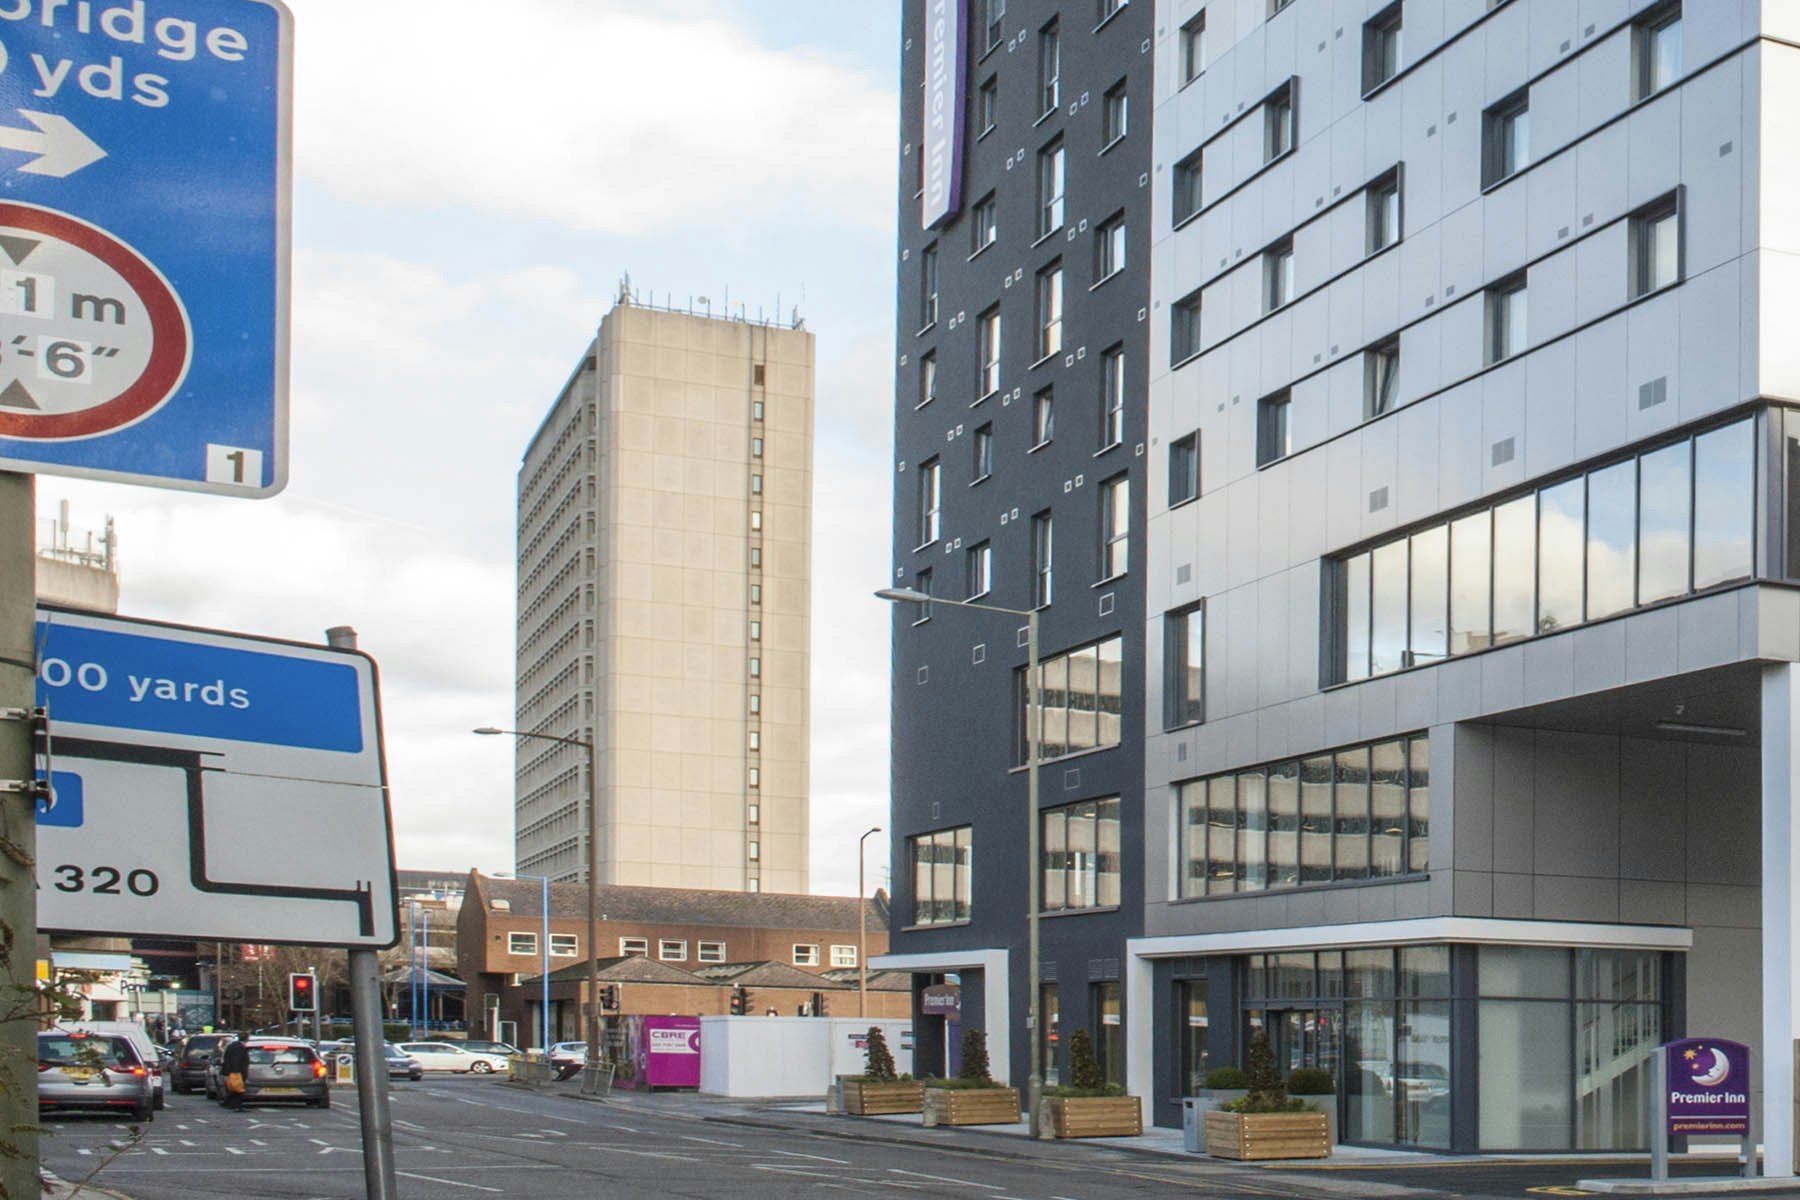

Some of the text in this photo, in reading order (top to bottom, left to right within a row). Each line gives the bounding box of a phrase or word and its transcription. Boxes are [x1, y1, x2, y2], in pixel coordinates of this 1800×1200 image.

[31, 53, 169, 108] yds
[930, 140, 946, 206] Inn
[71, 293, 126, 325] m
[227, 451, 243, 482] 1
[128, 675, 250, 709] yards
[1671, 1092, 1746, 1104] Premier Inn
[1673, 1121, 1745, 1131] premierinn.com
